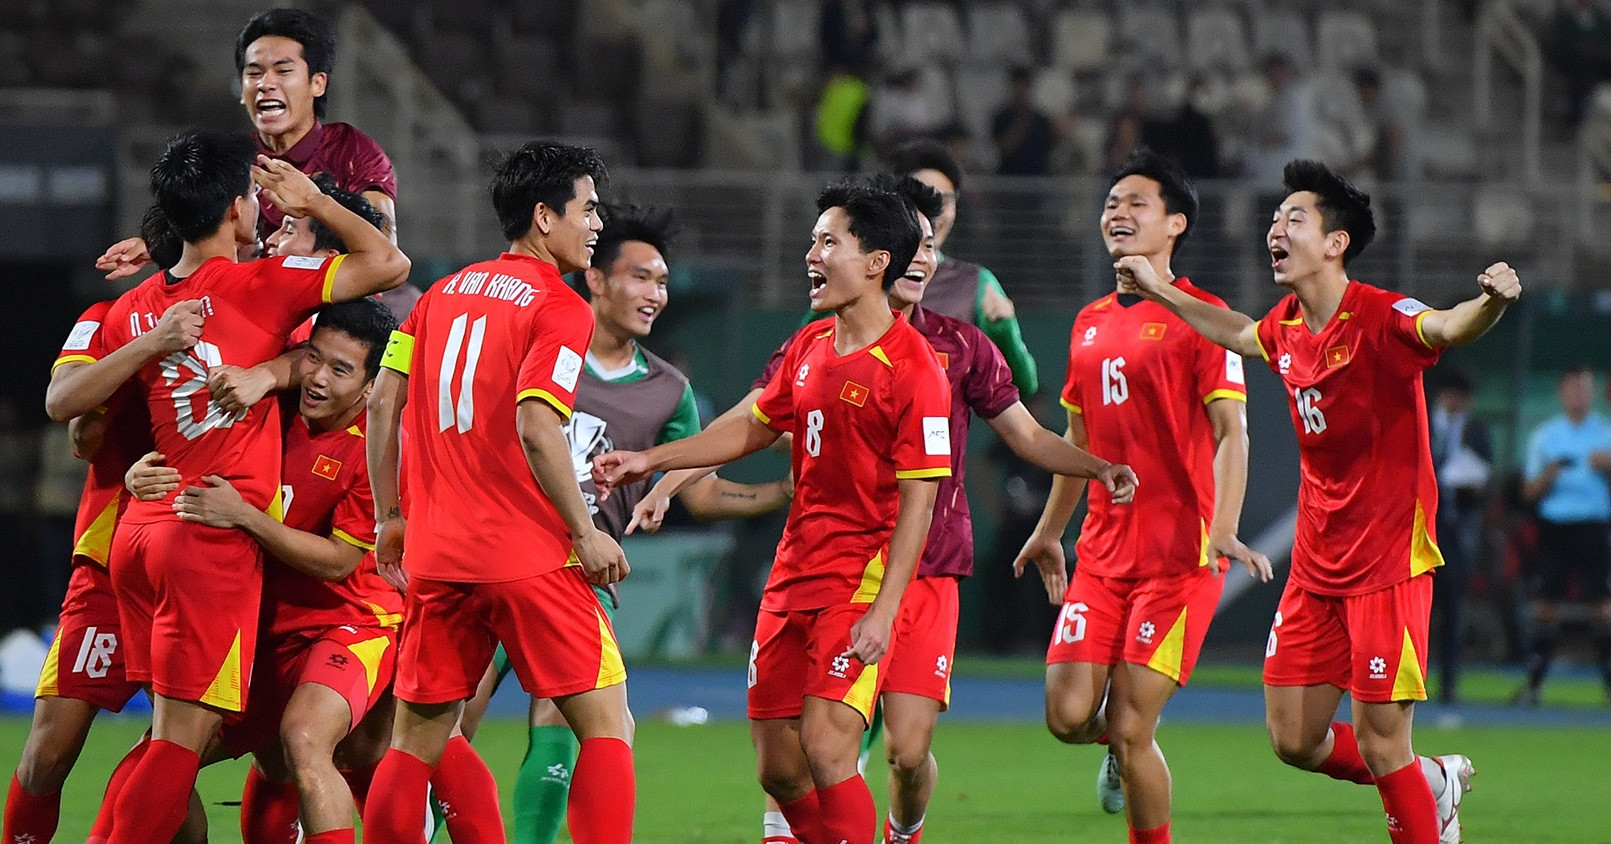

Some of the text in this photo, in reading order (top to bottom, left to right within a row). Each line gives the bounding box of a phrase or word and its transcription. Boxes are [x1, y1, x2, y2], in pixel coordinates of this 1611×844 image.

[458, 271, 490, 295] VAN
[483, 273, 540, 307] KHANG
[438, 312, 487, 434] 11
[1102, 356, 1129, 406] 15
[806, 409, 824, 457] 8
[1295, 387, 1327, 435] 16
[1054, 602, 1089, 645] 15
[72, 626, 118, 678] 18
